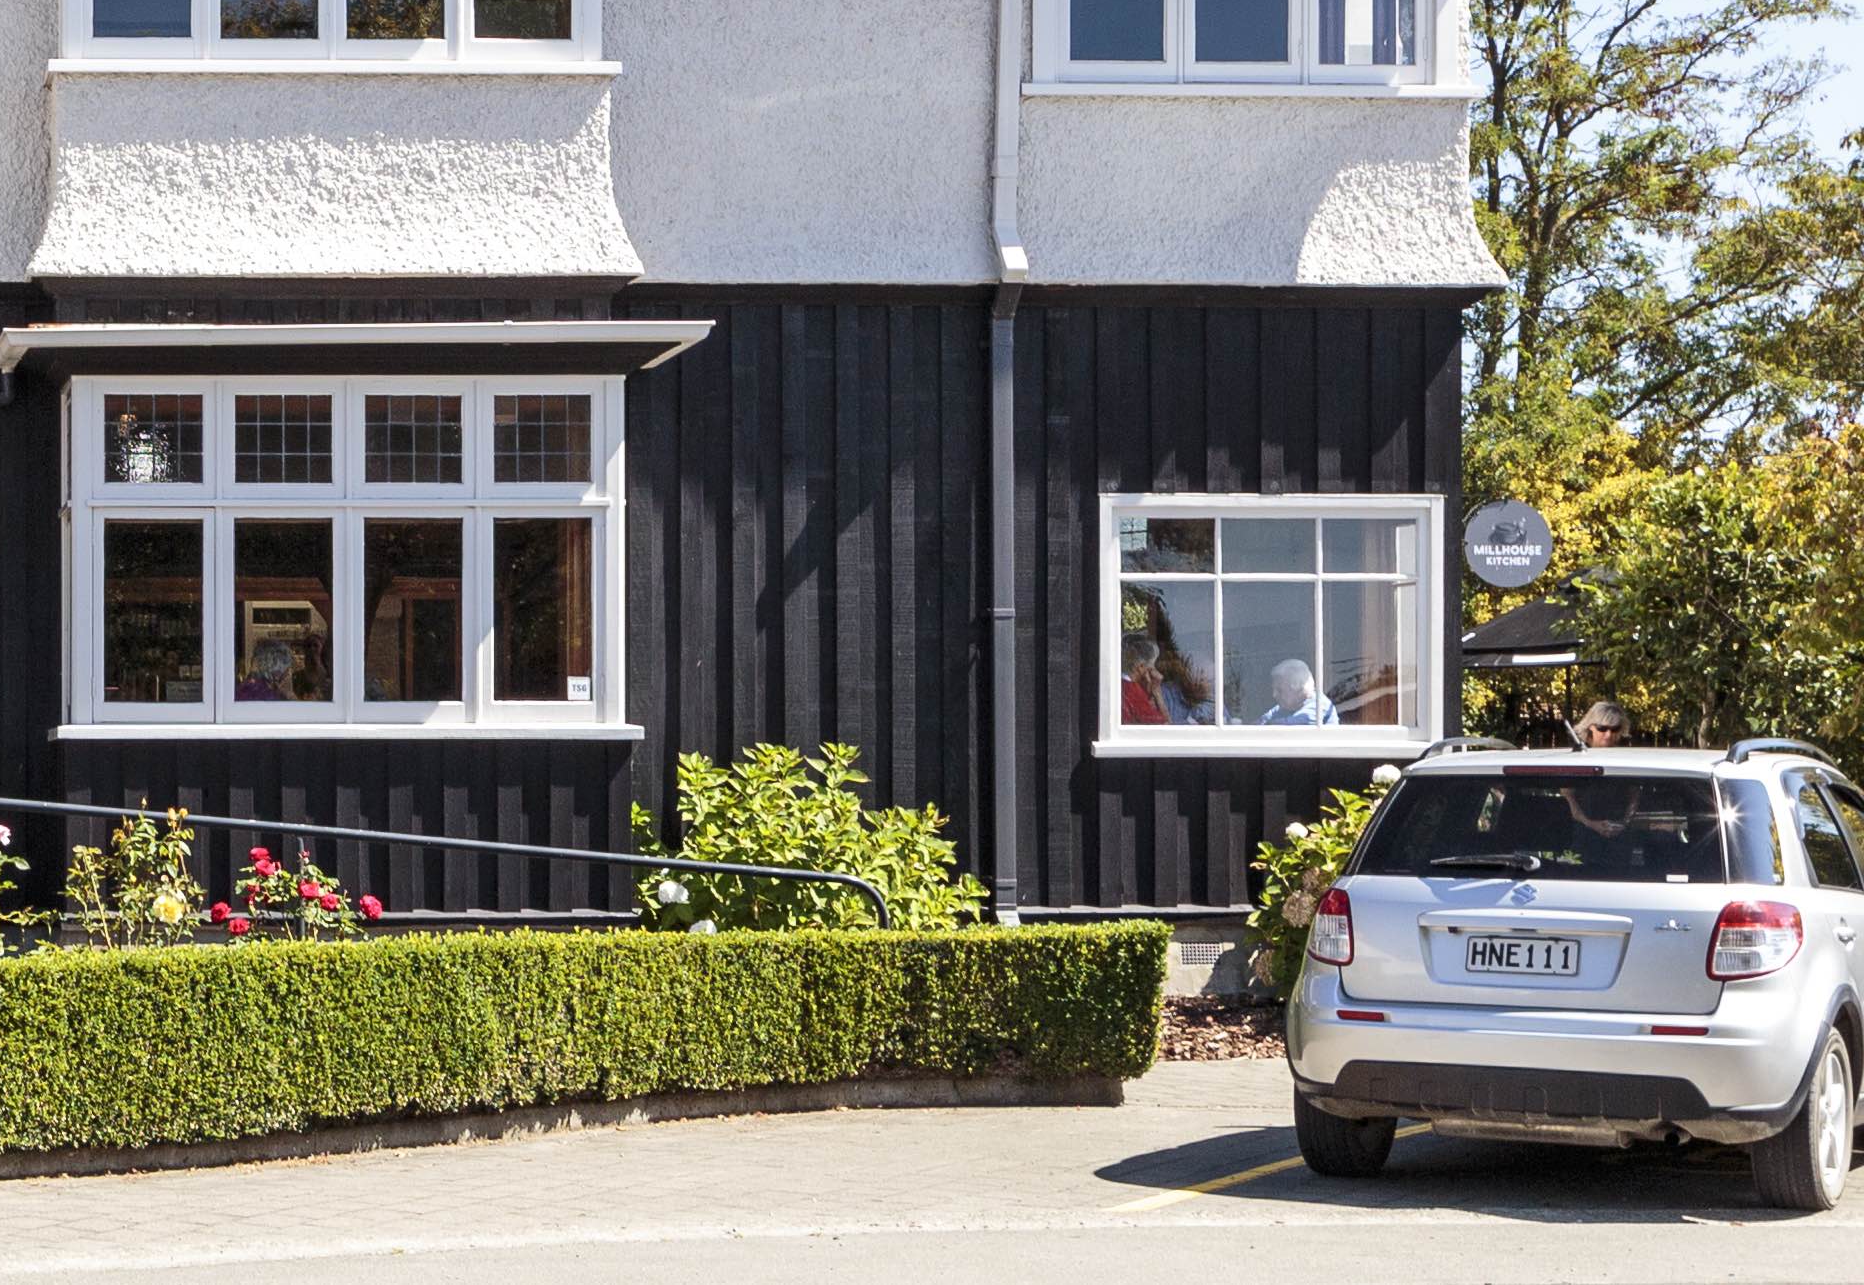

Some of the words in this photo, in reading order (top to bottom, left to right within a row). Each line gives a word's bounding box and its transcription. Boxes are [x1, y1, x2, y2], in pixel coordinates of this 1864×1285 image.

[1473, 545, 1542, 556] MILLHOUSE
[1486, 556, 1530, 566] KITCHEN
[1471, 941, 1570, 970] HNE111
